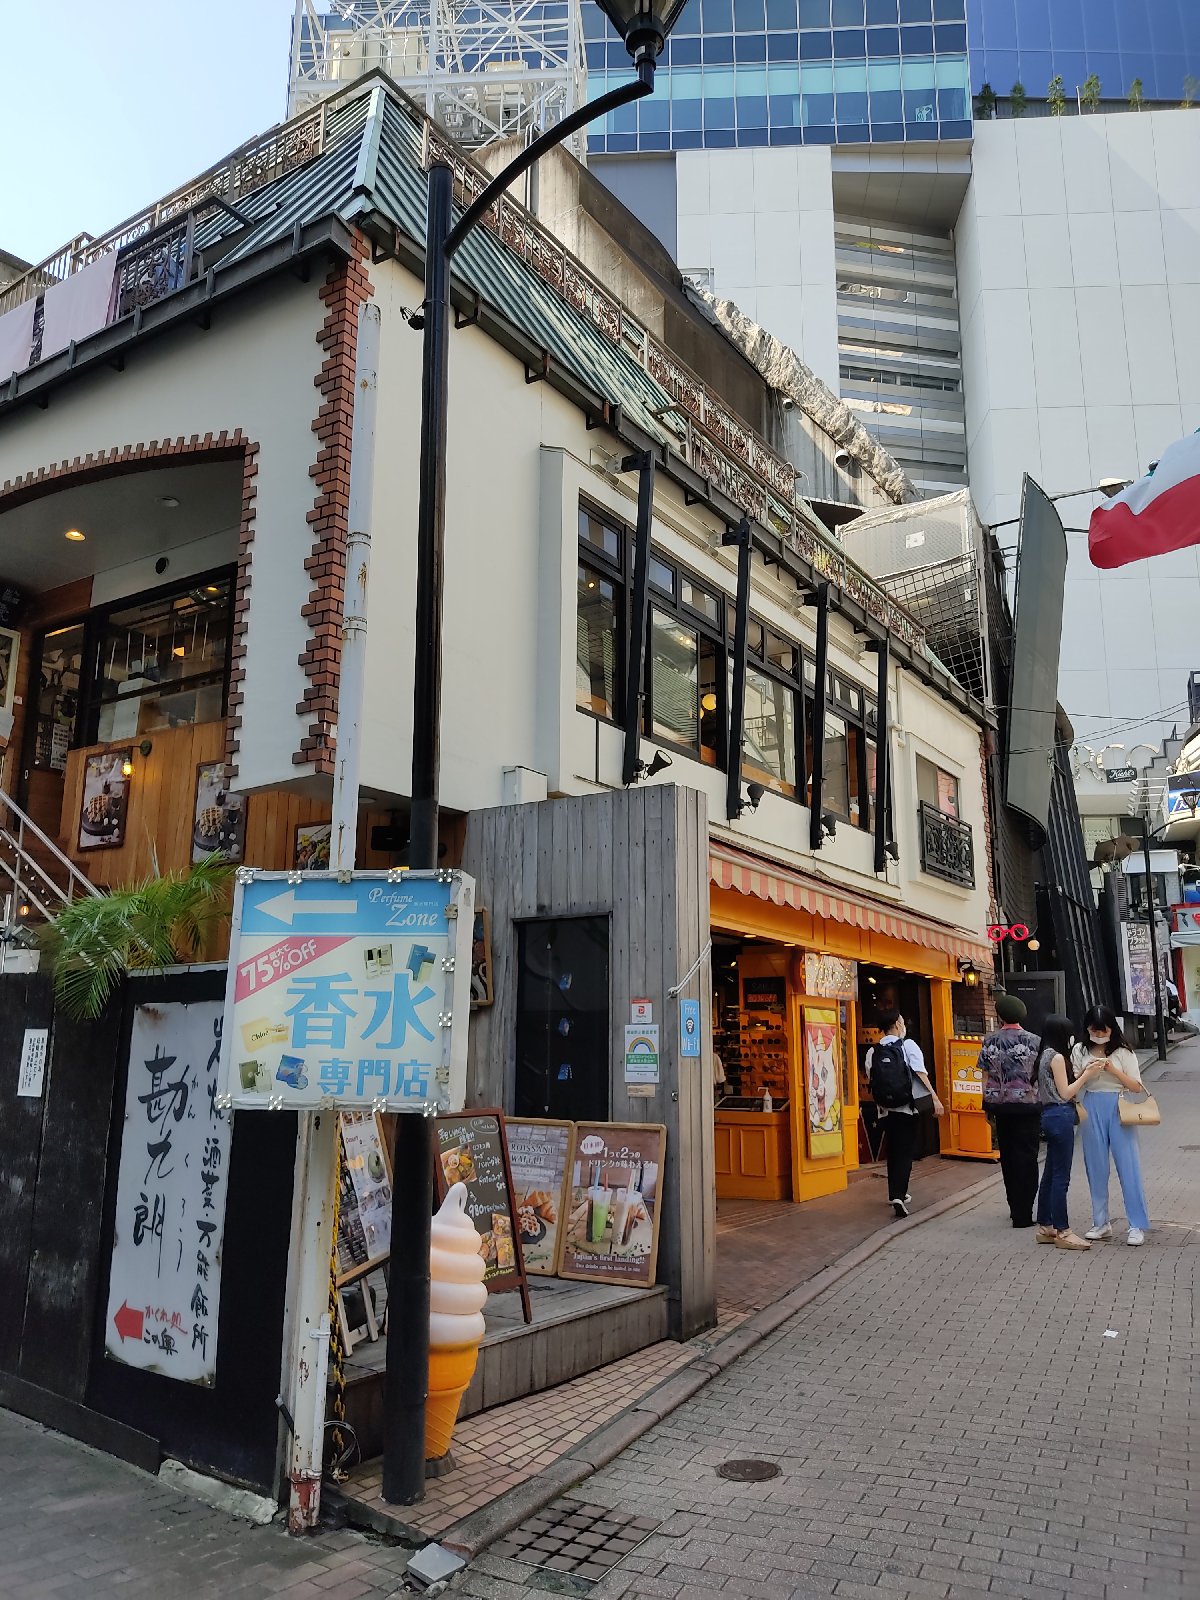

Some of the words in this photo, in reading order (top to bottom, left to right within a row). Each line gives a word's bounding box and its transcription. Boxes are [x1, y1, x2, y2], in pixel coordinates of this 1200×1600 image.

[1109, 769, 1135, 779] Kiehl's
[368, 887, 414, 906] Perfume
[385, 903, 439, 927] Zone
[240, 938, 317, 991] 75%OFF
[283, 971, 437, 1050] 香水
[684, 1003, 697, 1015] Free
[316, 1057, 432, 1097] 専門店
[510, 1142, 555, 1154] ROISSANT
[588, 1159, 653, 1169] ドリンクが味わえる!
[573, 1253, 598, 1262] Japan's
[599, 1254, 613, 1262] first
